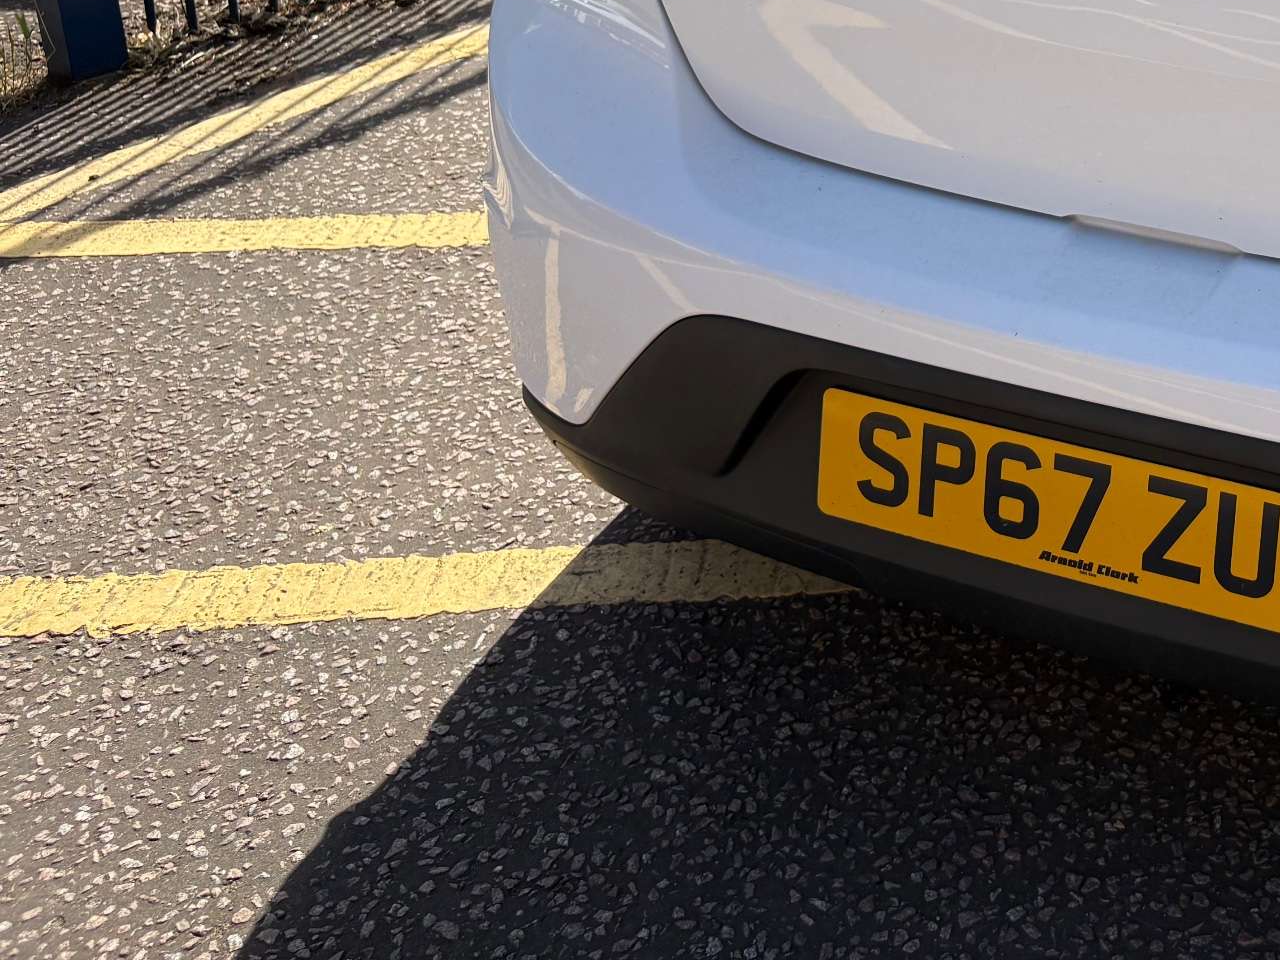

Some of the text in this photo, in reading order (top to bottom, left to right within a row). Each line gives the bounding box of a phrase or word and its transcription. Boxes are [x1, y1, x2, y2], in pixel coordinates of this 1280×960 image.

[856, 411, 1112, 554] SP67
[1039, 550, 1139, 584] Arnold Clark
